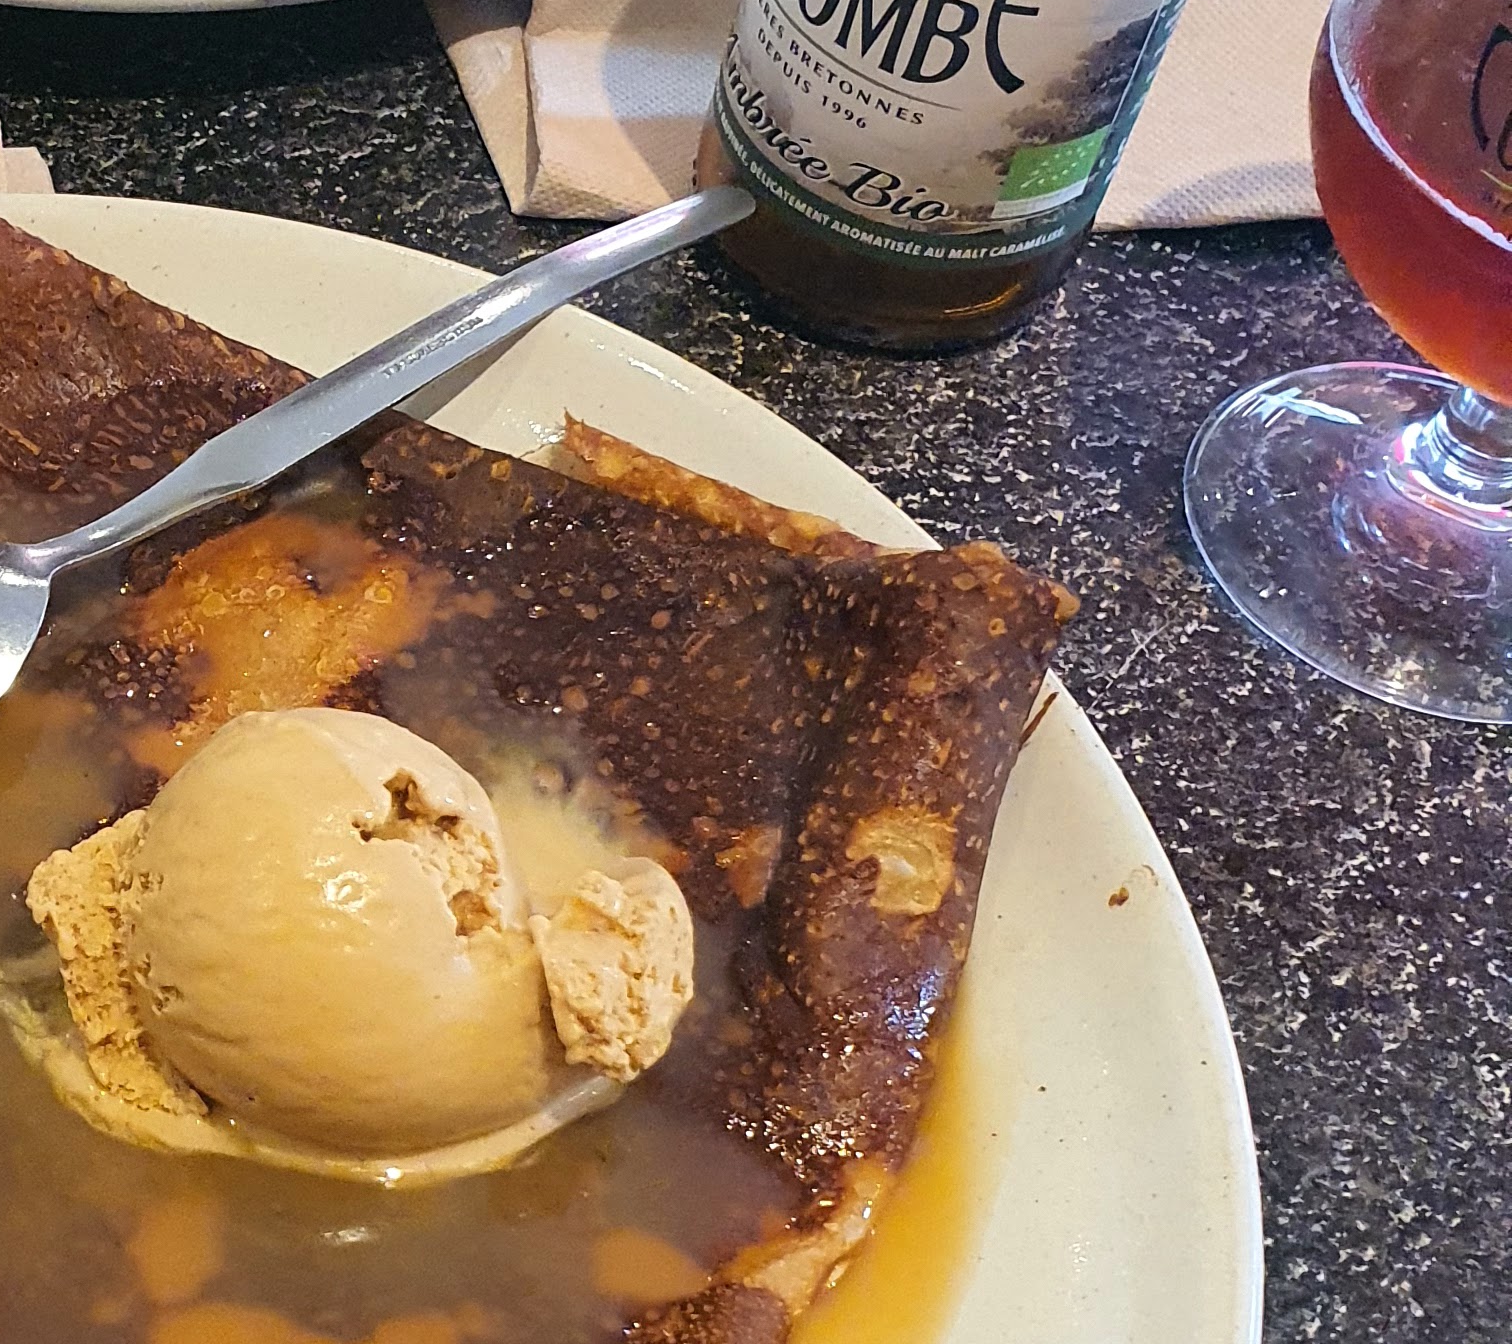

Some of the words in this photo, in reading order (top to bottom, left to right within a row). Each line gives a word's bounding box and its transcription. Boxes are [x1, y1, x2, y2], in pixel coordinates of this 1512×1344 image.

[757, 27, 813, 94] DEPUIS
[821, 94, 868, 129] 1996
[789, 39, 925, 126] BRETONNES
[843, 161, 954, 222] Bio
[830, 219, 921, 256] AROMATISÉE
[923, 246, 945, 259] AU
[947, 247, 989, 259] MALT
